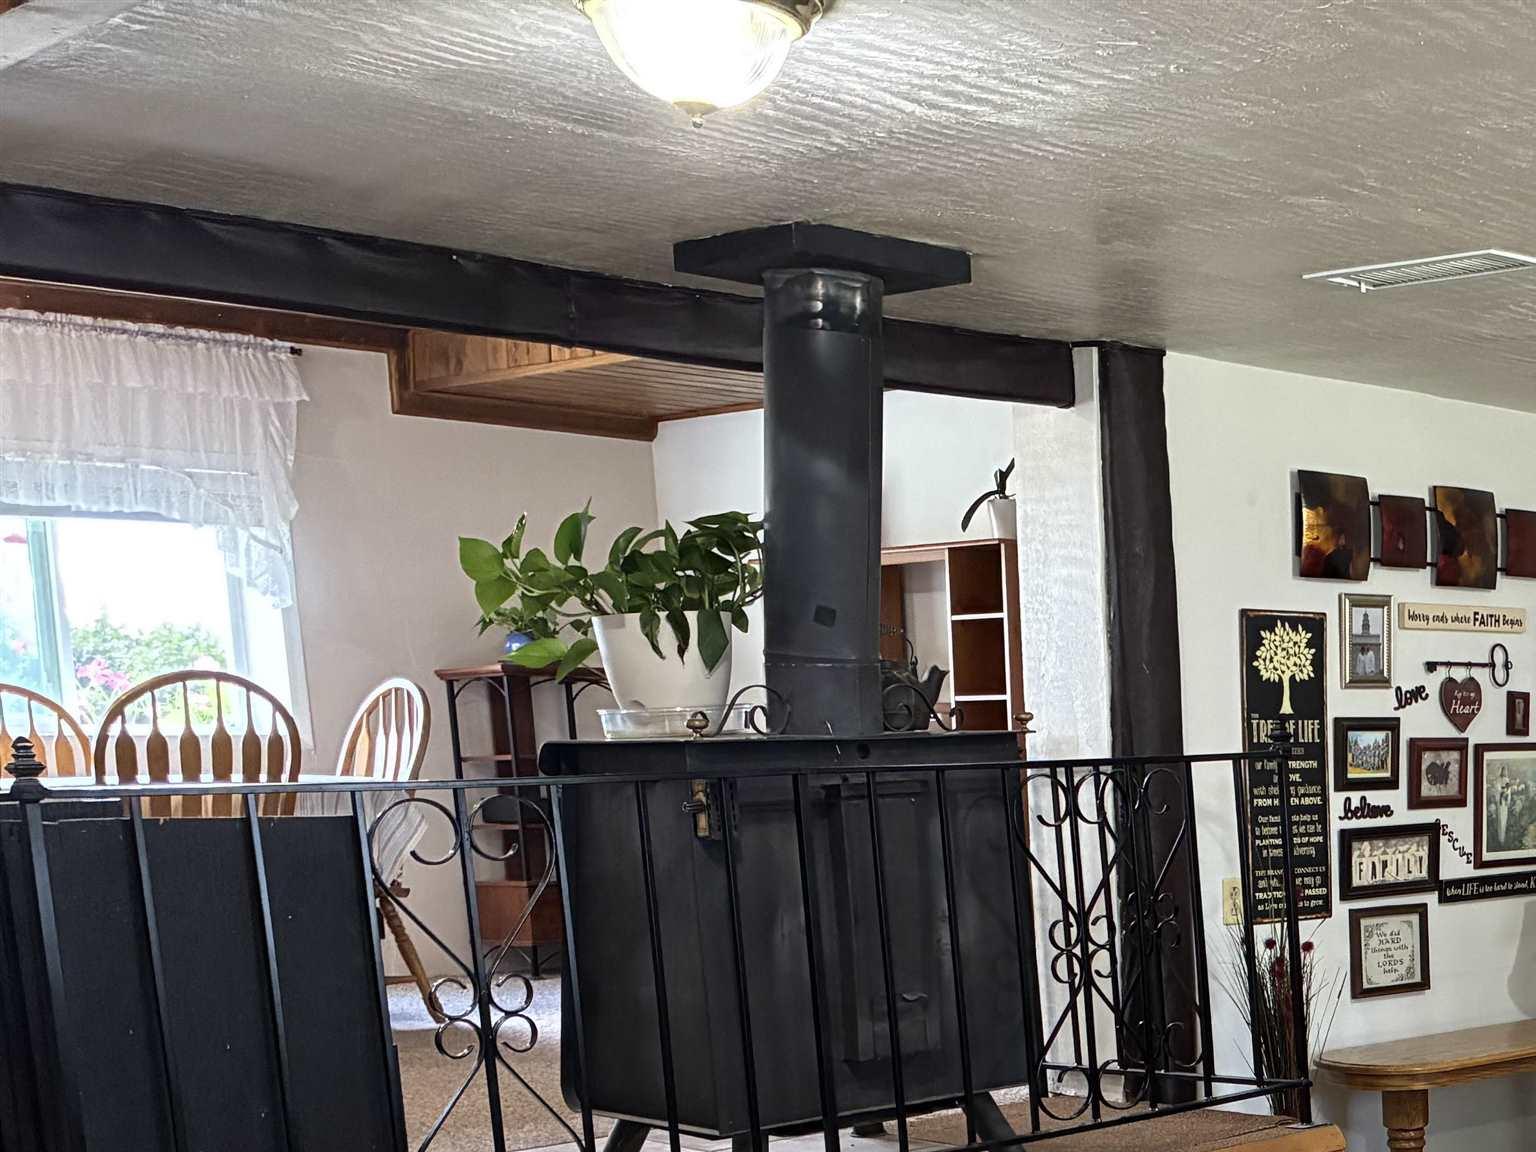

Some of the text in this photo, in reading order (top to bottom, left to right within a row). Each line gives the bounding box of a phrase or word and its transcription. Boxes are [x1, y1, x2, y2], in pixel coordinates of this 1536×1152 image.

[1407, 608, 1523, 629] Worry ends where FAITH Begins
[1393, 684, 1430, 711] love
[1450, 699, 1480, 714] Heart
[1297, 719, 1321, 743] LIFE
[1287, 760, 1318, 769] TRENGTH
[1253, 798, 1273, 807] FROM
[1338, 795, 1394, 820] believe
[1304, 887, 1328, 896] PASSED
[1462, 882, 1480, 896] LIFE
